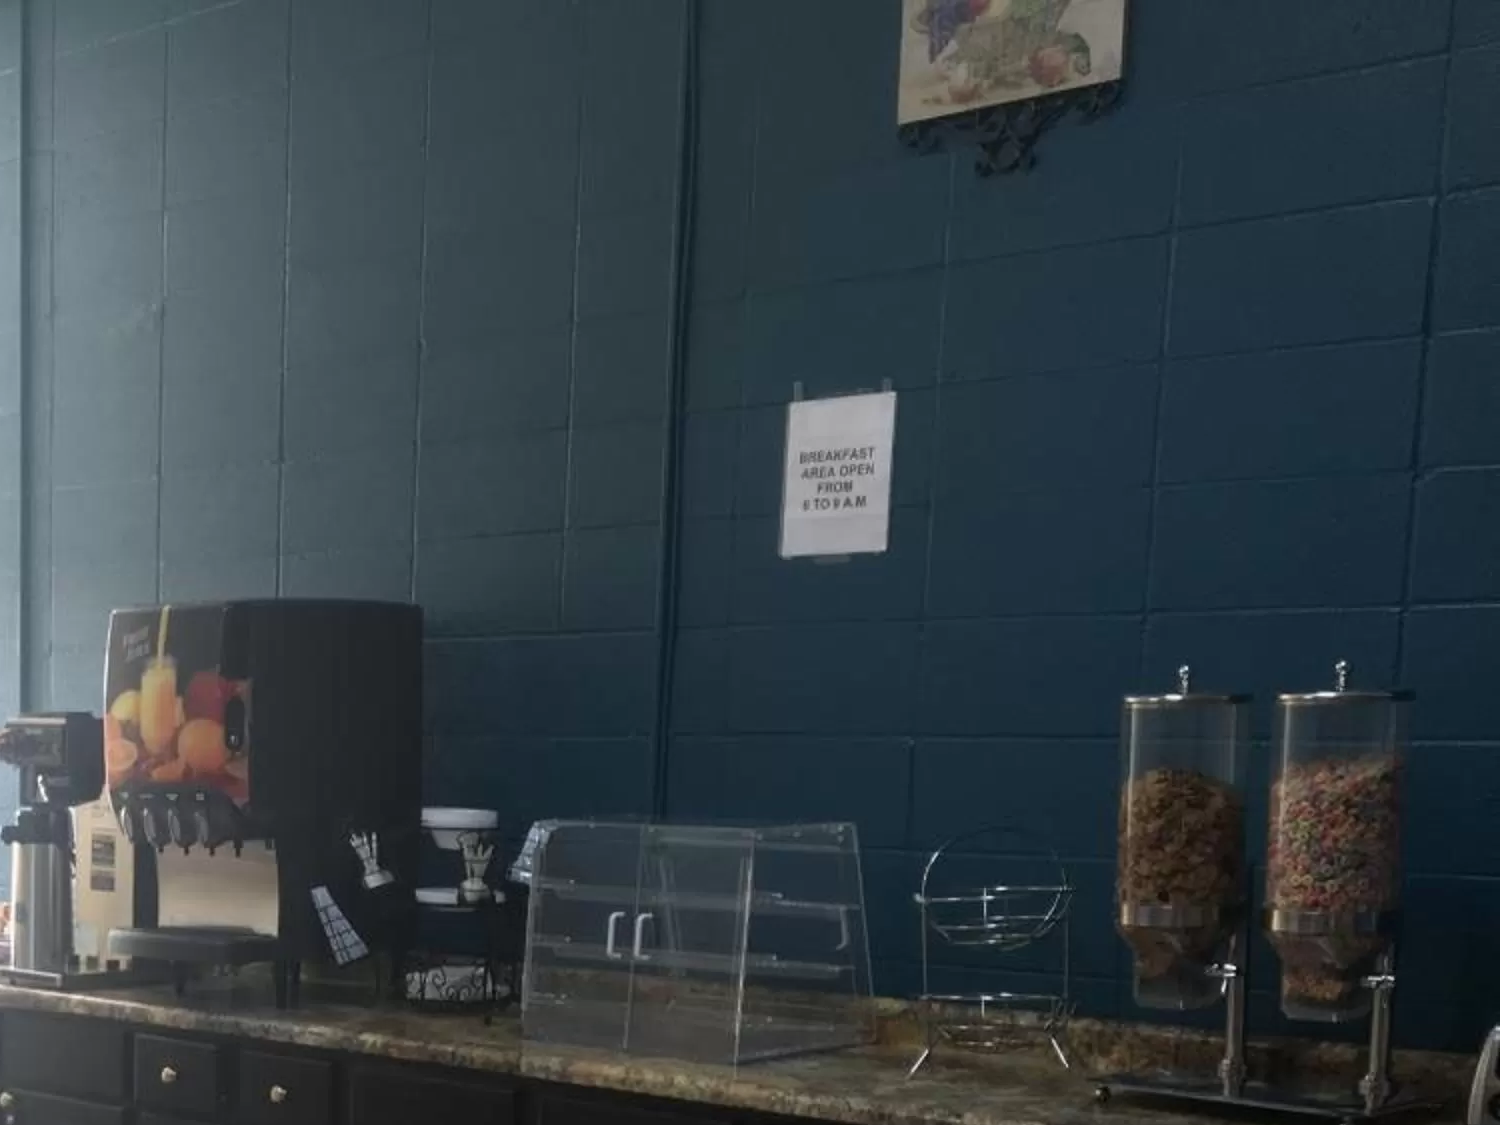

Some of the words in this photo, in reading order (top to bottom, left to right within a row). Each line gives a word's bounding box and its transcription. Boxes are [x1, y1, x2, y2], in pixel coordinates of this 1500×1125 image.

[799, 447, 875, 464] BREAKFAST
[801, 467, 836, 480] AREA
[839, 463, 875, 477] OPEN
[817, 480, 853, 494] FROM
[813, 498, 831, 511] TO
